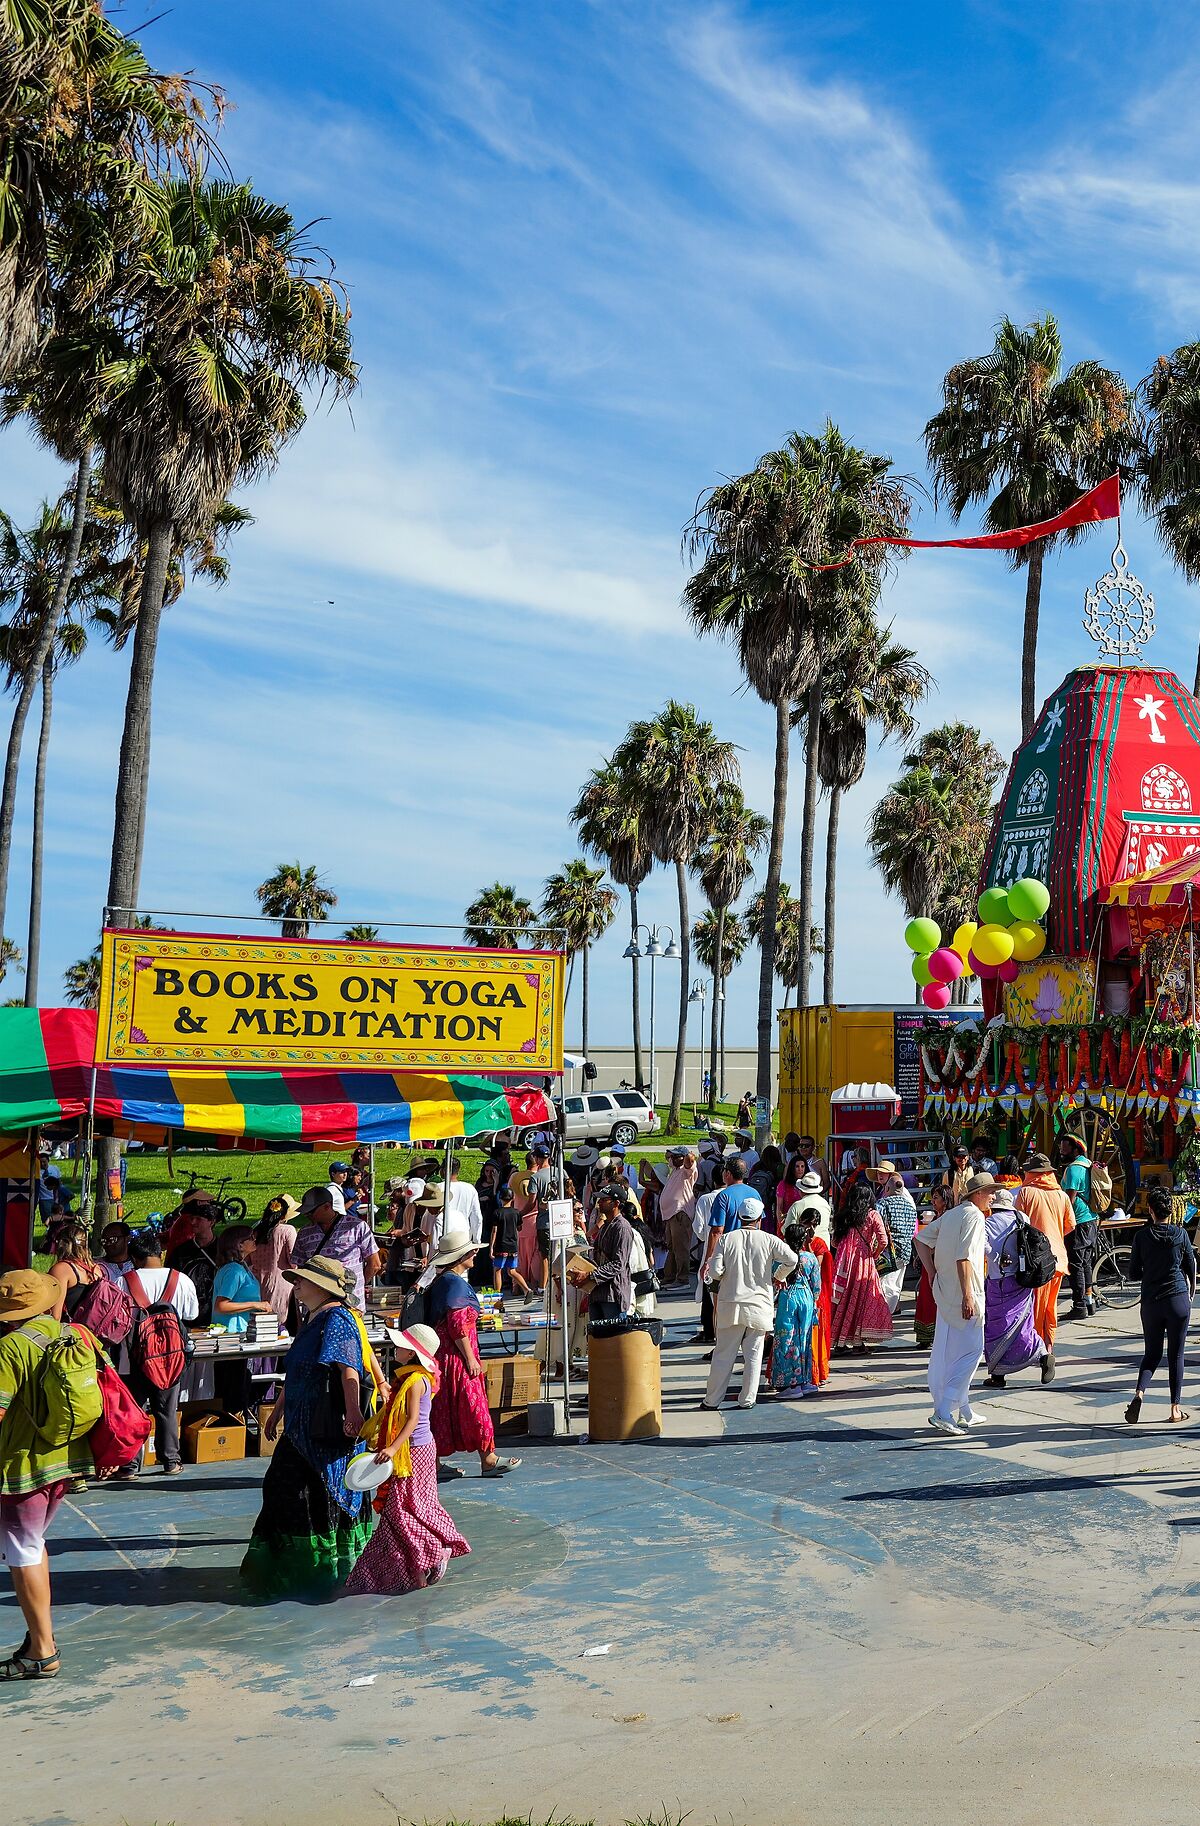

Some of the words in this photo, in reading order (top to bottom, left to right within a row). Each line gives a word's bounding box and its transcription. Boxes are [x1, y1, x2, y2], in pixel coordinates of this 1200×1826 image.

[153, 968, 318, 1002] BOOKS
[340, 976, 399, 1004] ON
[413, 978, 527, 1009] YOGA
[173, 1006, 208, 1034] &
[228, 1007, 504, 1041] MEDITATION
